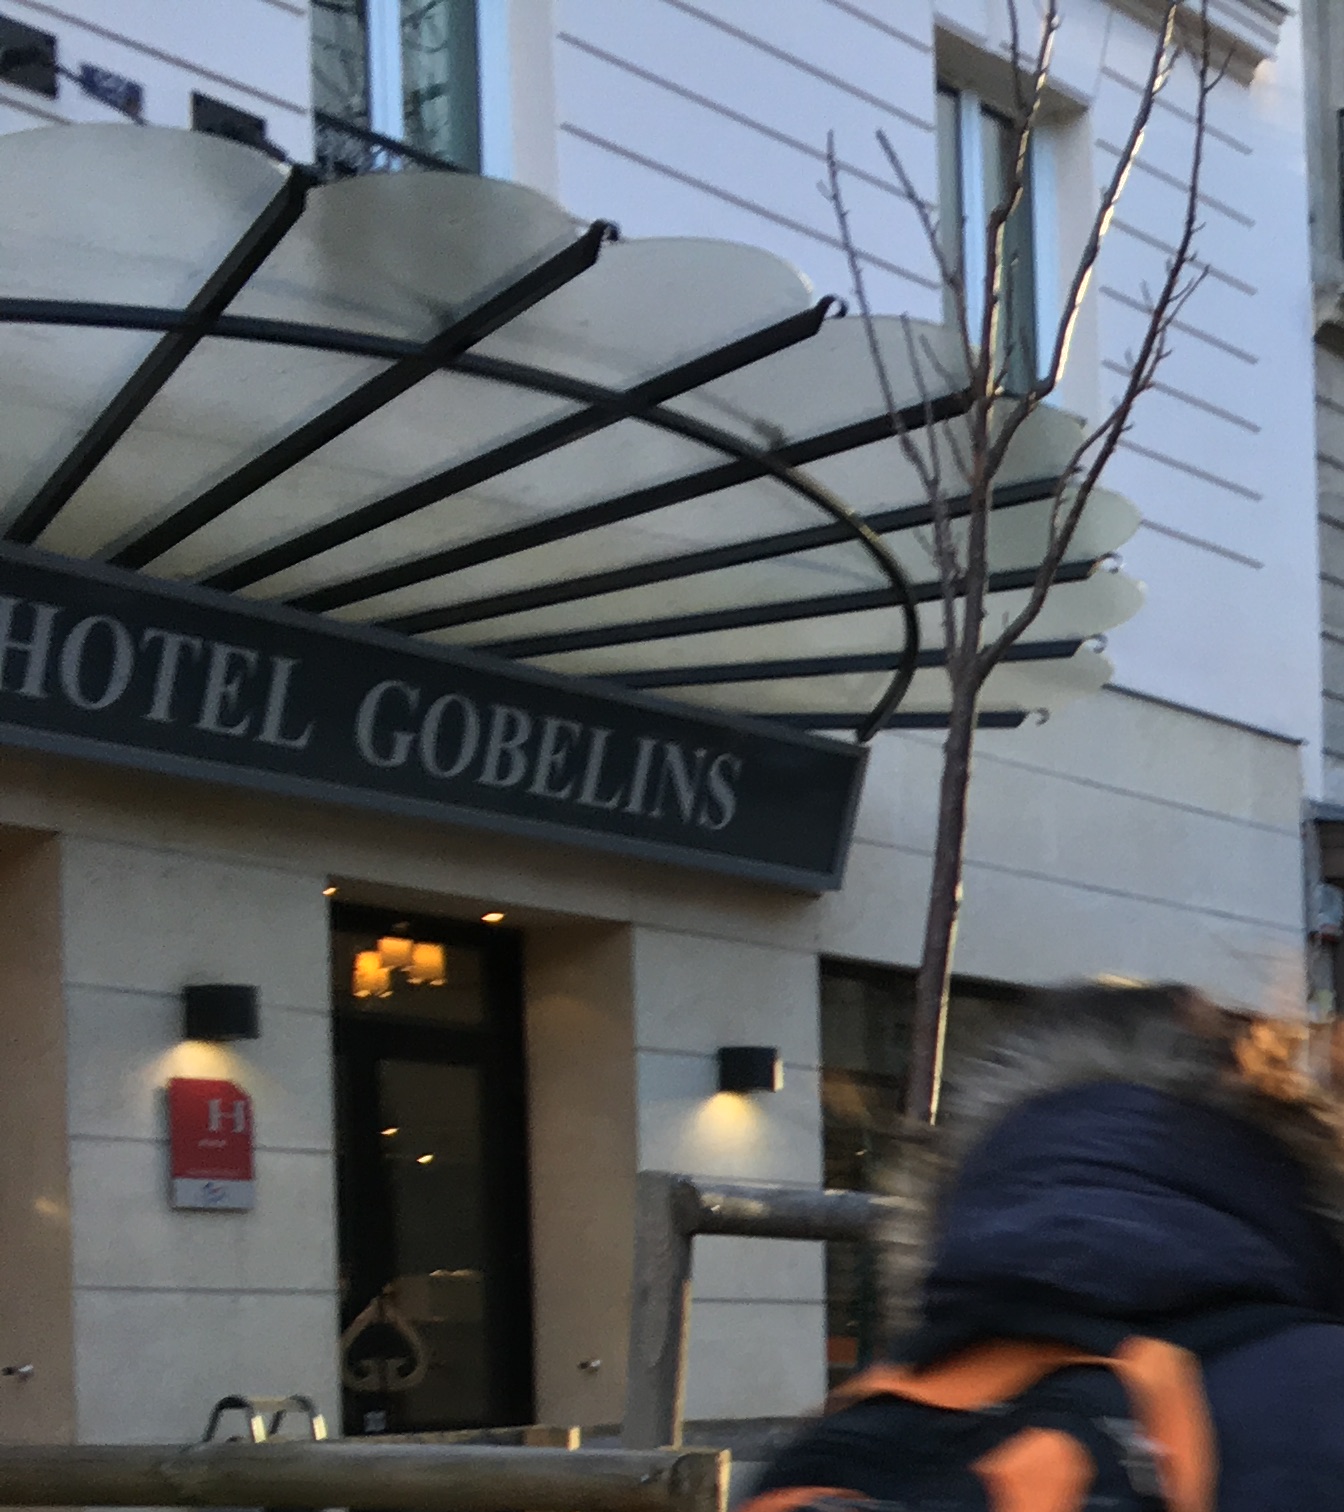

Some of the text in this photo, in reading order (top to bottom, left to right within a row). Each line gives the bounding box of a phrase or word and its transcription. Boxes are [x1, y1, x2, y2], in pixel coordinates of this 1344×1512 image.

[0, 597, 742, 831] HOTEL GOBELINS
[207, 1098, 246, 1134] H
